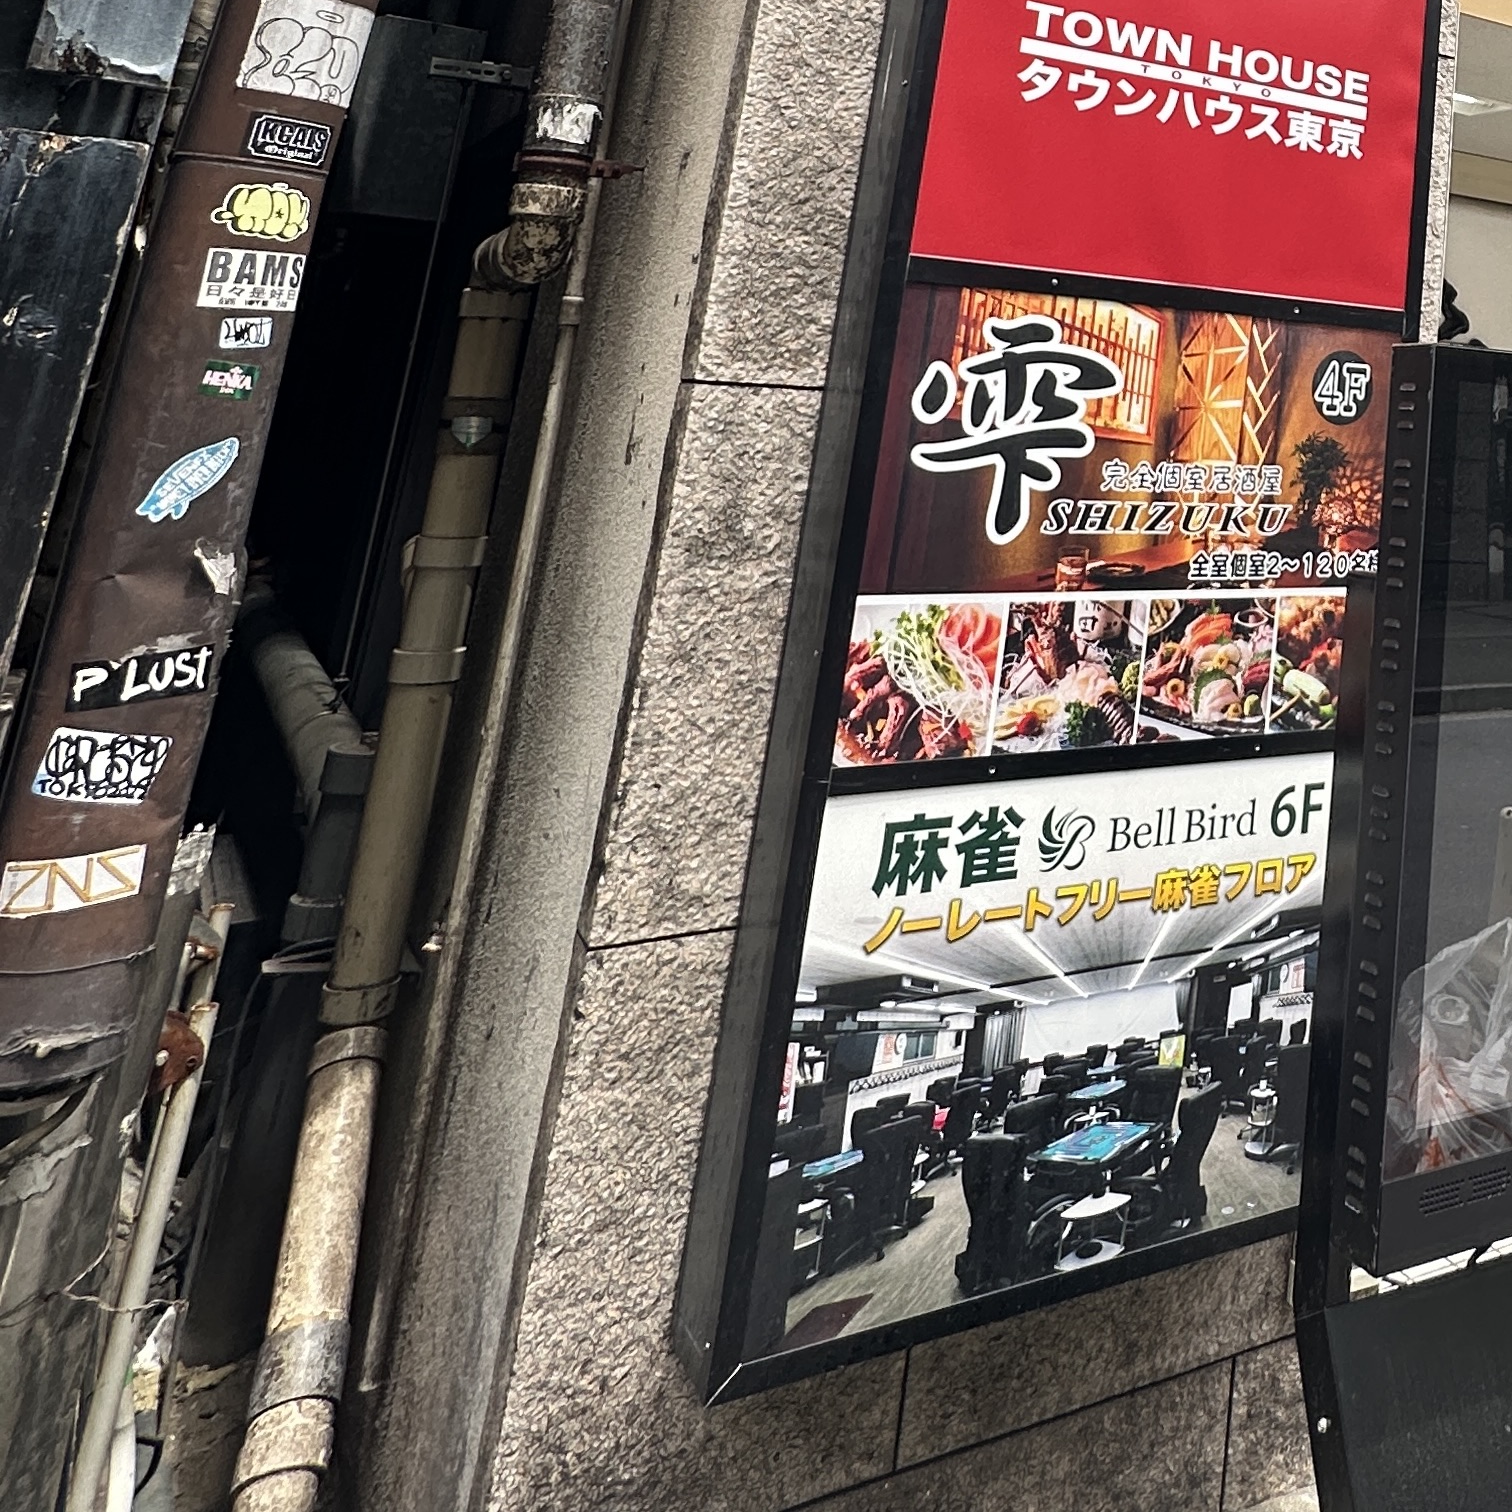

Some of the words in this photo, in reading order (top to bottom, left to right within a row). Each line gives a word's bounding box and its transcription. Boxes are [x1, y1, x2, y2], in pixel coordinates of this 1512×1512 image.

[1025, 0, 1192, 66] TOWN
[1207, 39, 1370, 104] HOUSE
[1017, 55, 1366, 161] タウンハウス東京
[1140, 63, 1272, 99] TOKYO
[206, 250, 303, 289] BAMS
[1314, 358, 1372, 415] 4F
[1100, 458, 1286, 498] 完全個室居酒屋
[1040, 497, 1294, 537] SHIZUKU
[871, 804, 1026, 899] 麻雀
[1270, 781, 1326, 838] 6F
[863, 851, 1317, 956] ノーレートフリー麻雀フロア
